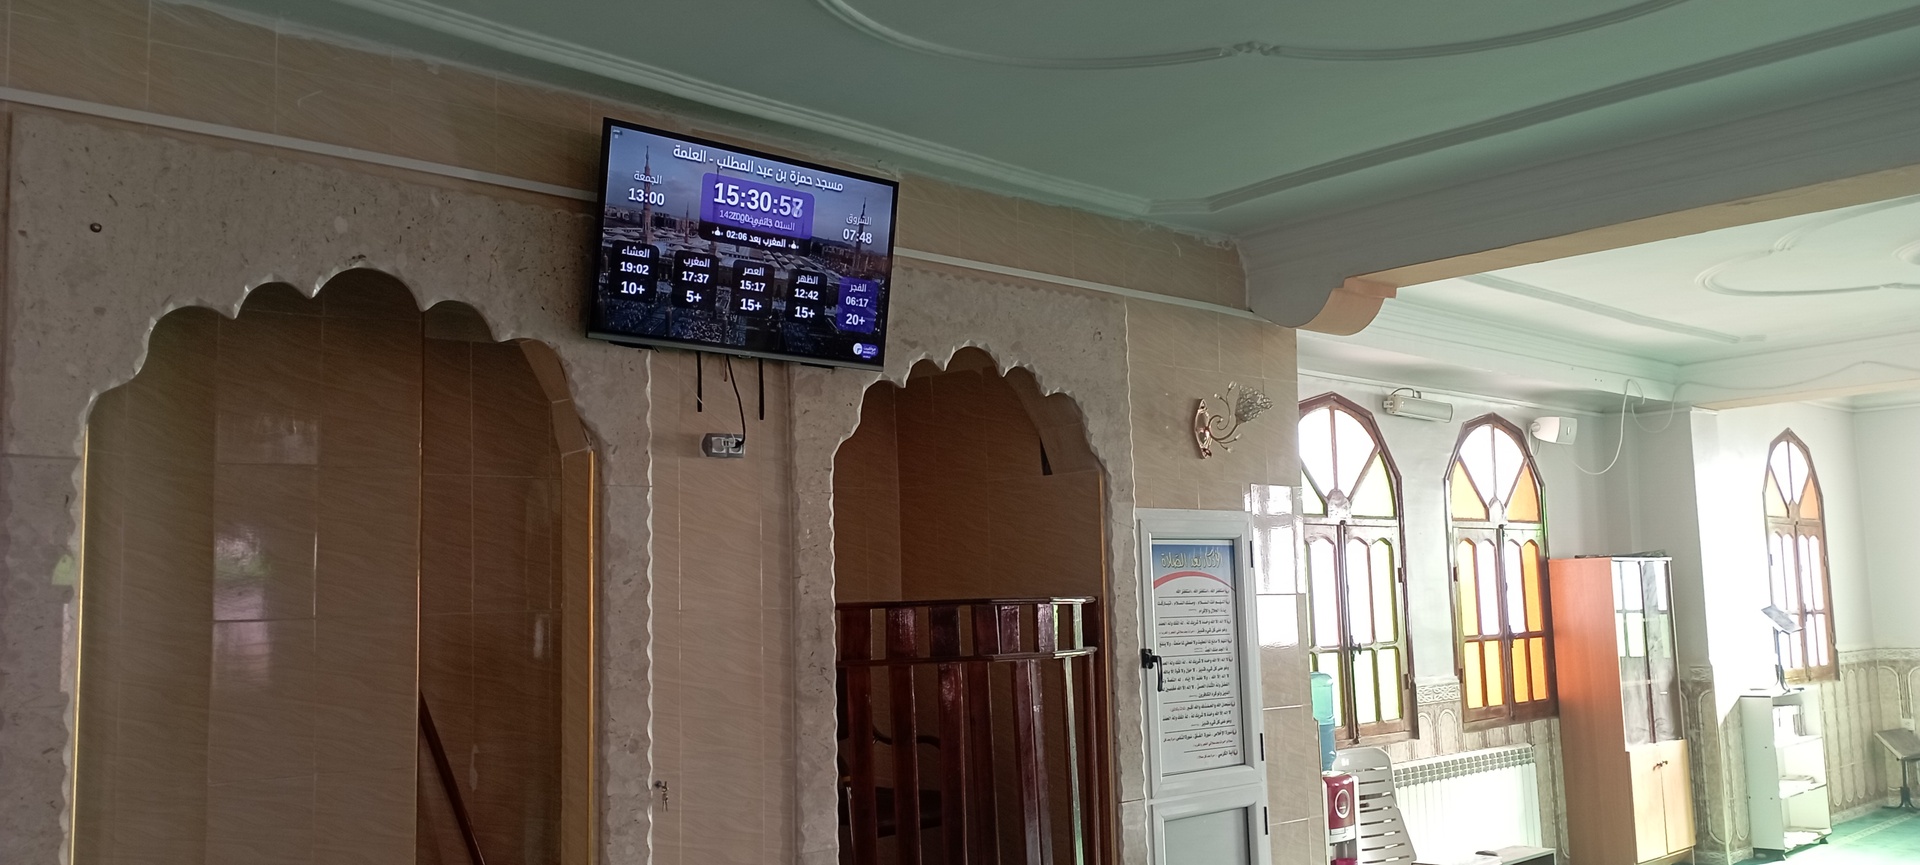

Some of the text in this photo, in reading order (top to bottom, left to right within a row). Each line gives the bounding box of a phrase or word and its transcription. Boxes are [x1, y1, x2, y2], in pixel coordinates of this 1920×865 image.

[673, 144, 707, 163] العلمة
[716, 156, 754, 173] المطلب
[757, 164, 773, 178] عبد
[633, 170, 663, 185] الجمعة
[775, 169, 787, 182] بن
[789, 170, 813, 186] حمزة
[815, 177, 843, 192] مسجد
[628, 187, 665, 206] 13:00
[846, 214, 873, 226] الشروق
[726, 230, 786, 248] المغرب بعد 02:06
[843, 228, 873, 244] 07:48
[622, 246, 650, 258] العشاء
[620, 261, 649, 275] 19:02
[683, 257, 710, 268] المغرب
[682, 270, 709, 284] 17:37
[743, 265, 764, 277] العصر
[740, 279, 766, 292] 15:17
[796, 274, 819, 285] الظهر
[794, 288, 819, 301] 12:42
[849, 282, 867, 293] الفجر
[846, 296, 869, 308] 06:17
